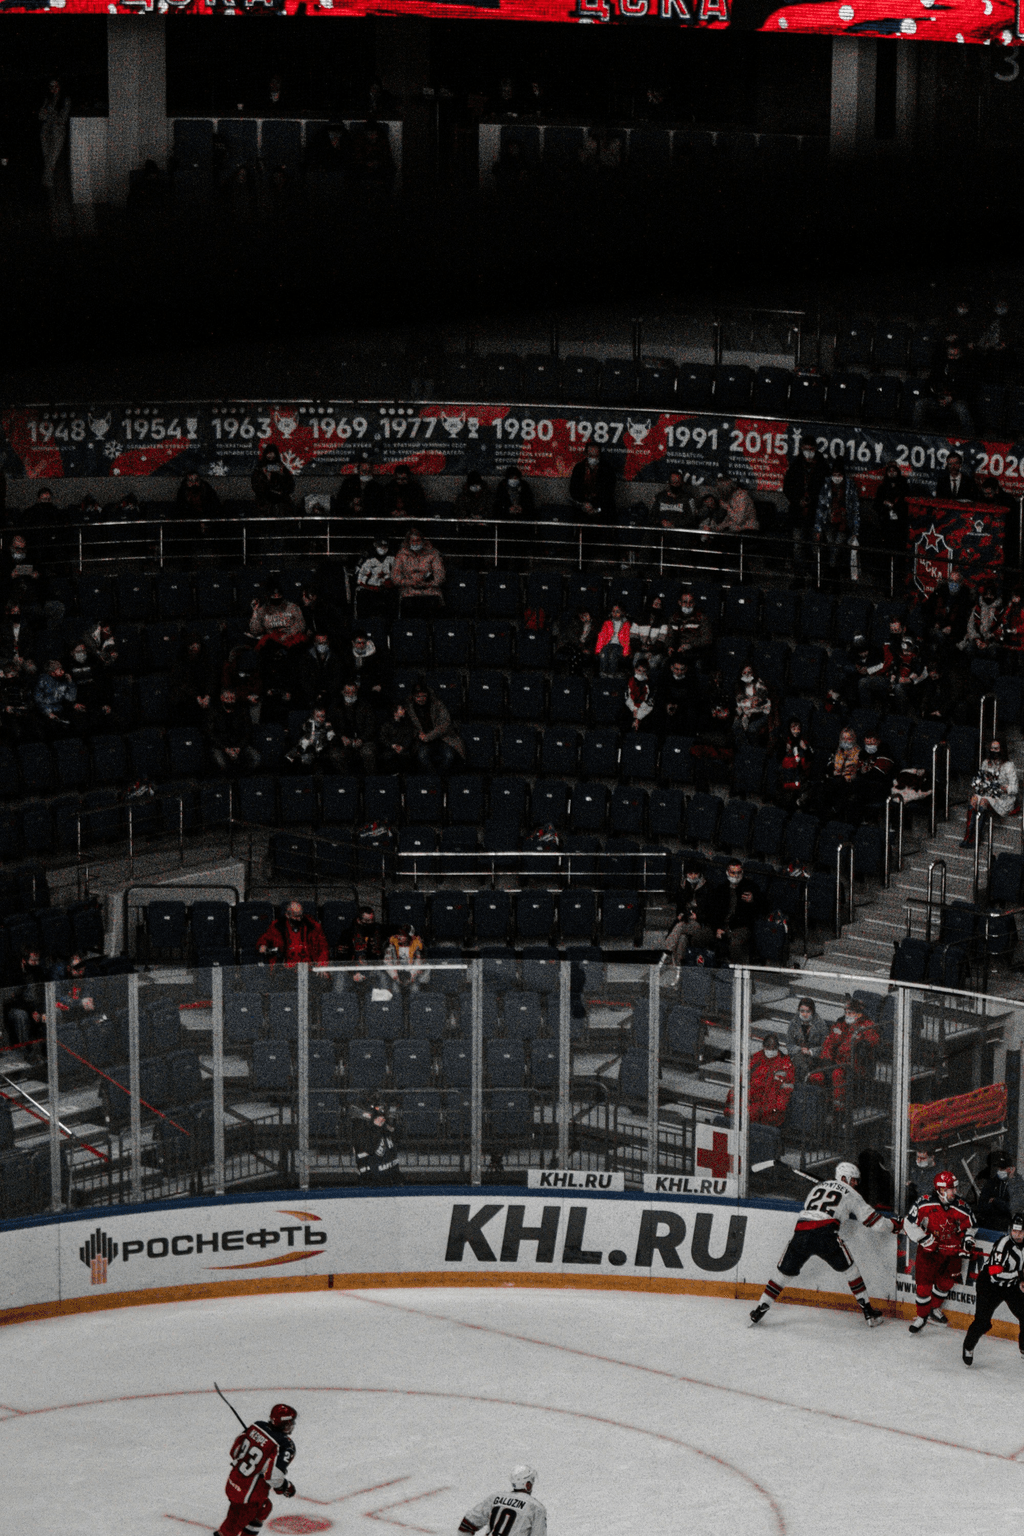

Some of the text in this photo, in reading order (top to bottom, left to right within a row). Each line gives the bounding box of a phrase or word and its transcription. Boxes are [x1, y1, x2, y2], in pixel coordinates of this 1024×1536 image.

[27, 418, 86, 443] 1948
[121, 416, 184, 440] 1954
[211, 417, 272, 439] 1963
[308, 416, 368, 439] 1969
[379, 417, 438, 439] 1977
[491, 418, 555, 441] 1980
[565, 420, 624, 444] 1987
[664, 426, 719, 451] 1991
[728, 429, 789, 456] 2015
[540, 1172, 613, 1189] KHL.RU
[655, 1176, 728, 1195] KHL.RU
[807, 1188, 842, 1218] 22
[122, 1225, 327, 1262] РОСНЕФТЬ
[444, 1204, 748, 1272] KHL.RU
[493, 1496, 527, 1510] GALUZIN
